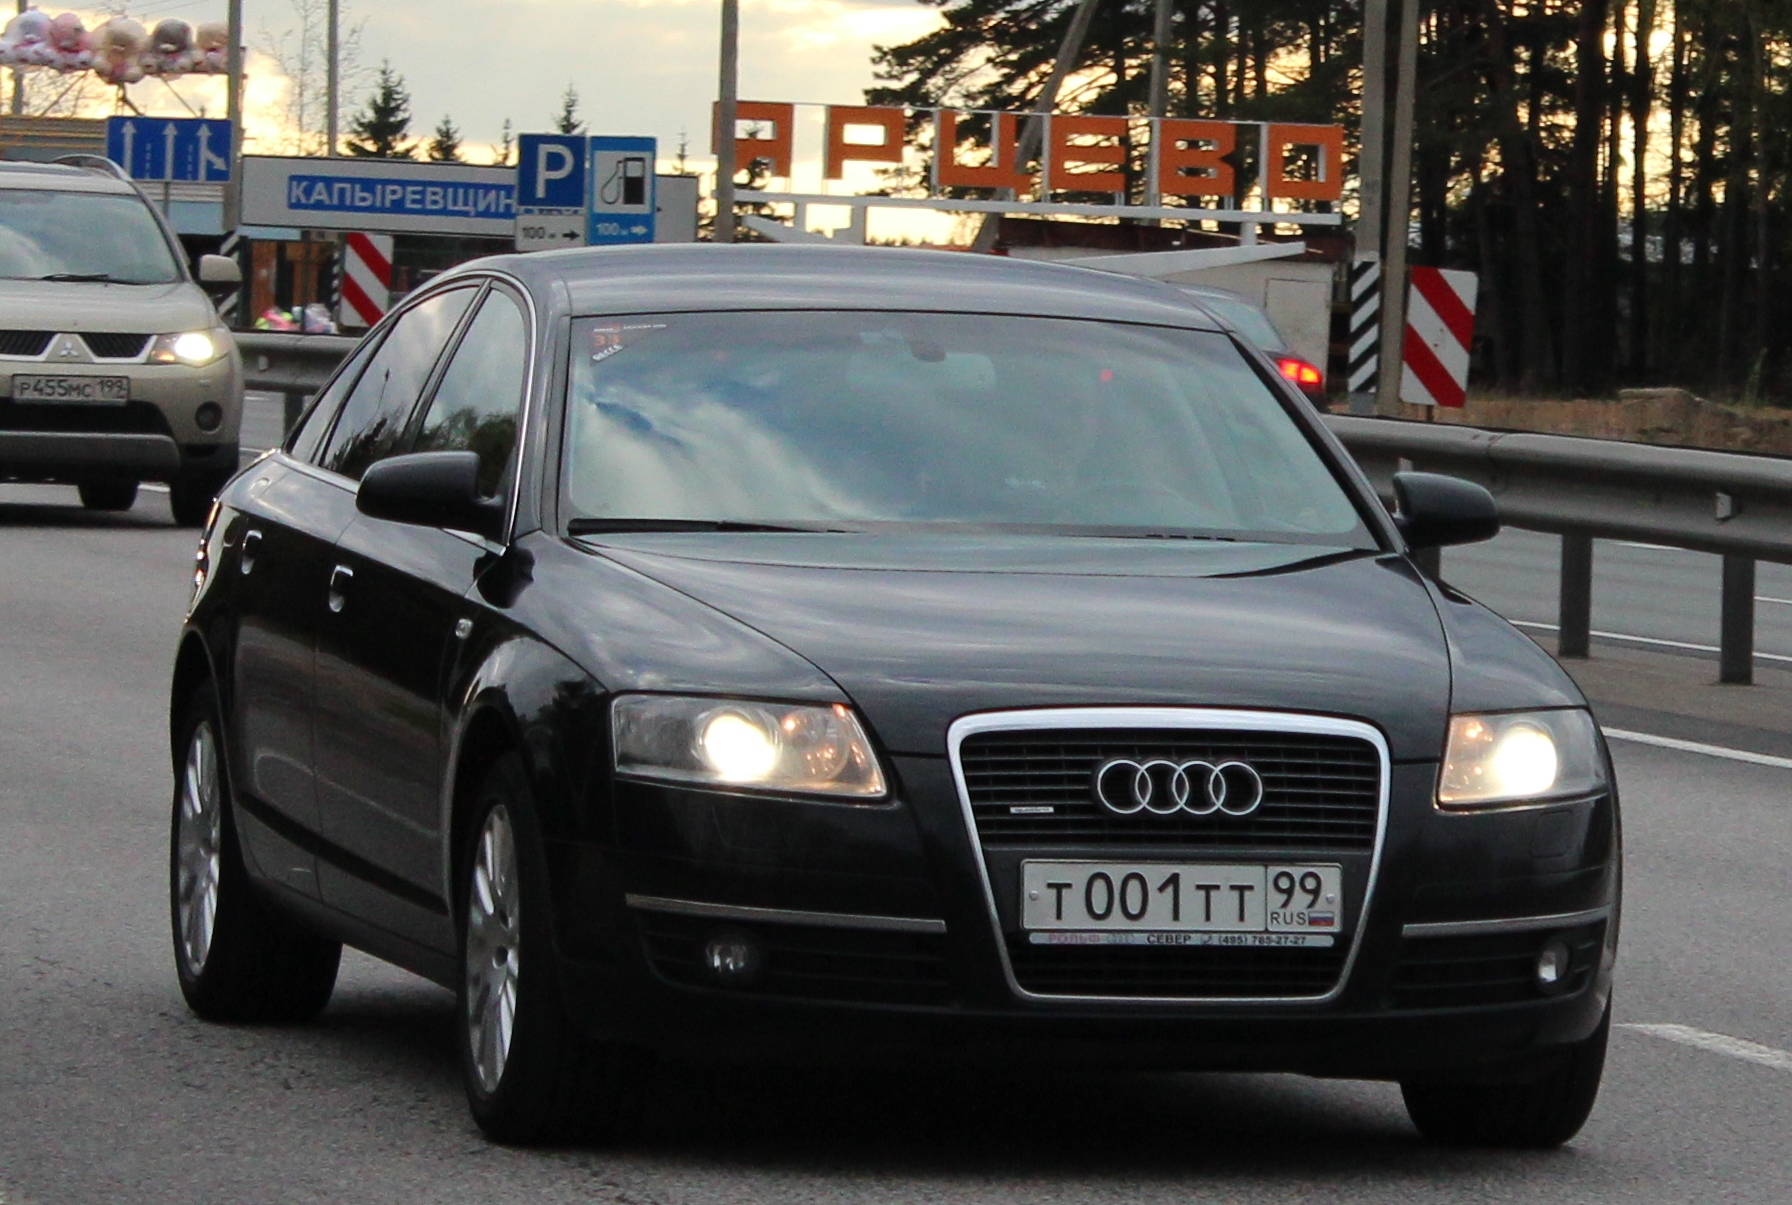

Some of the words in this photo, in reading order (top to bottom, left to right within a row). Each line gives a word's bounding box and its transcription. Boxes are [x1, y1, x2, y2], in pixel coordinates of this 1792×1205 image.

[535, 143, 575, 199] P
[290, 180, 517, 216] КАПЫРЕВЩИН
[521, 226, 546, 240] 100
[1046, 871, 1255, 922] Т001ТТ
[1272, 871, 1323, 909] 99
[1270, 911, 1307, 926] RUS
[1146, 933, 1192, 945] СЕВЕР
[1217, 934, 1249, 946] (495)
